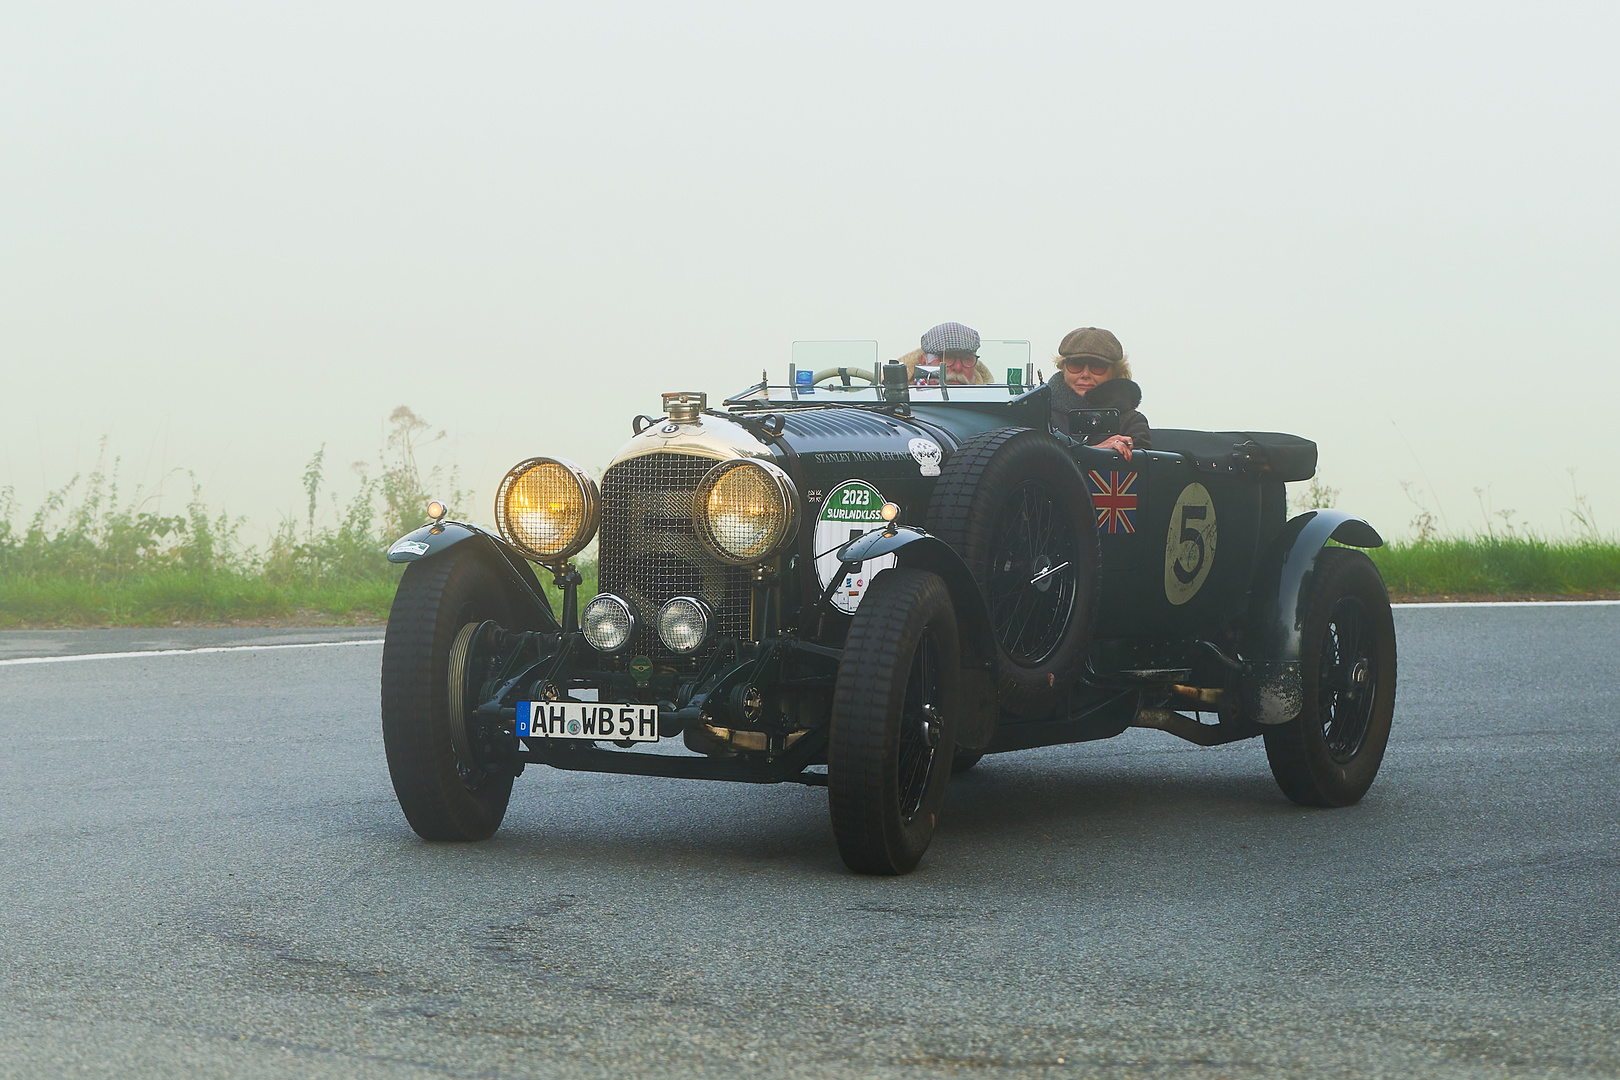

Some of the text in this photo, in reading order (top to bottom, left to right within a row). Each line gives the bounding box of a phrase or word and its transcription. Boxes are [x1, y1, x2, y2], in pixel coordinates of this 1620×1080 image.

[814, 452, 851, 464] STANLEY
[852, 451, 880, 462] MANN
[880, 450, 912, 461] RACING
[841, 489, 870, 506] 2023
[1173, 505, 1207, 585] 5
[520, 722, 527, 731] D
[531, 705, 566, 734] AH
